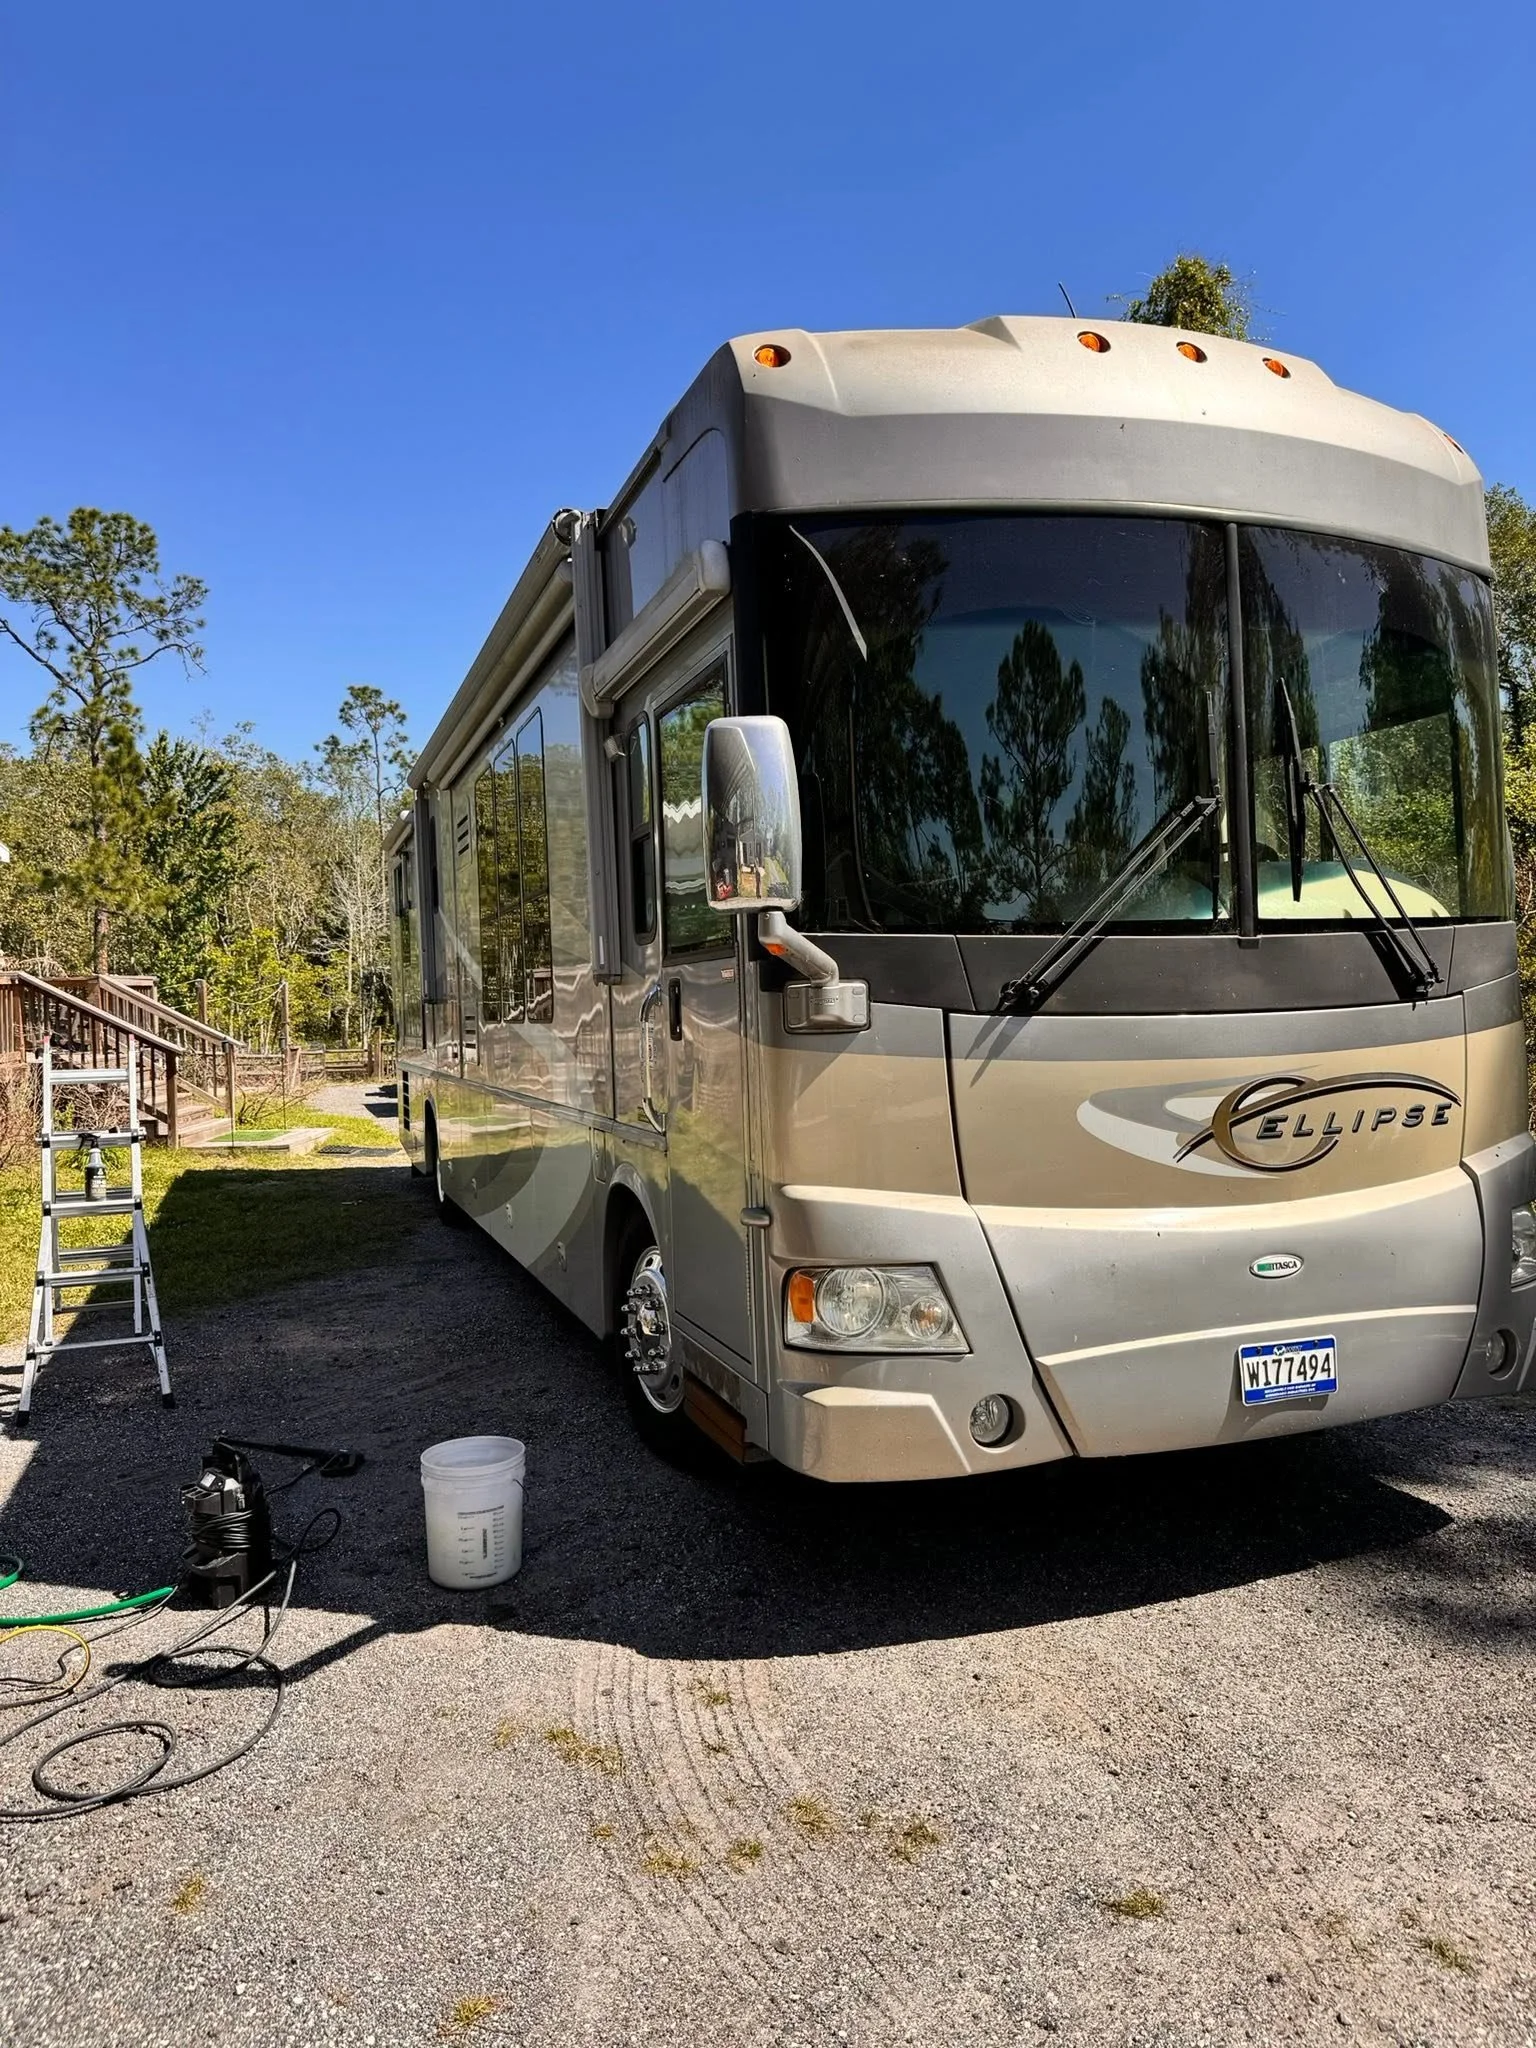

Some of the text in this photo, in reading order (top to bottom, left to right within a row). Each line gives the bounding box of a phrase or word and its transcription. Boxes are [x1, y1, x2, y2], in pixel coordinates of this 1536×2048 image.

[1256, 1103, 1452, 1139] ELLIPSE
[1271, 1260, 1298, 1271] ITASCA
[1246, 1352, 1331, 1388] W177494
